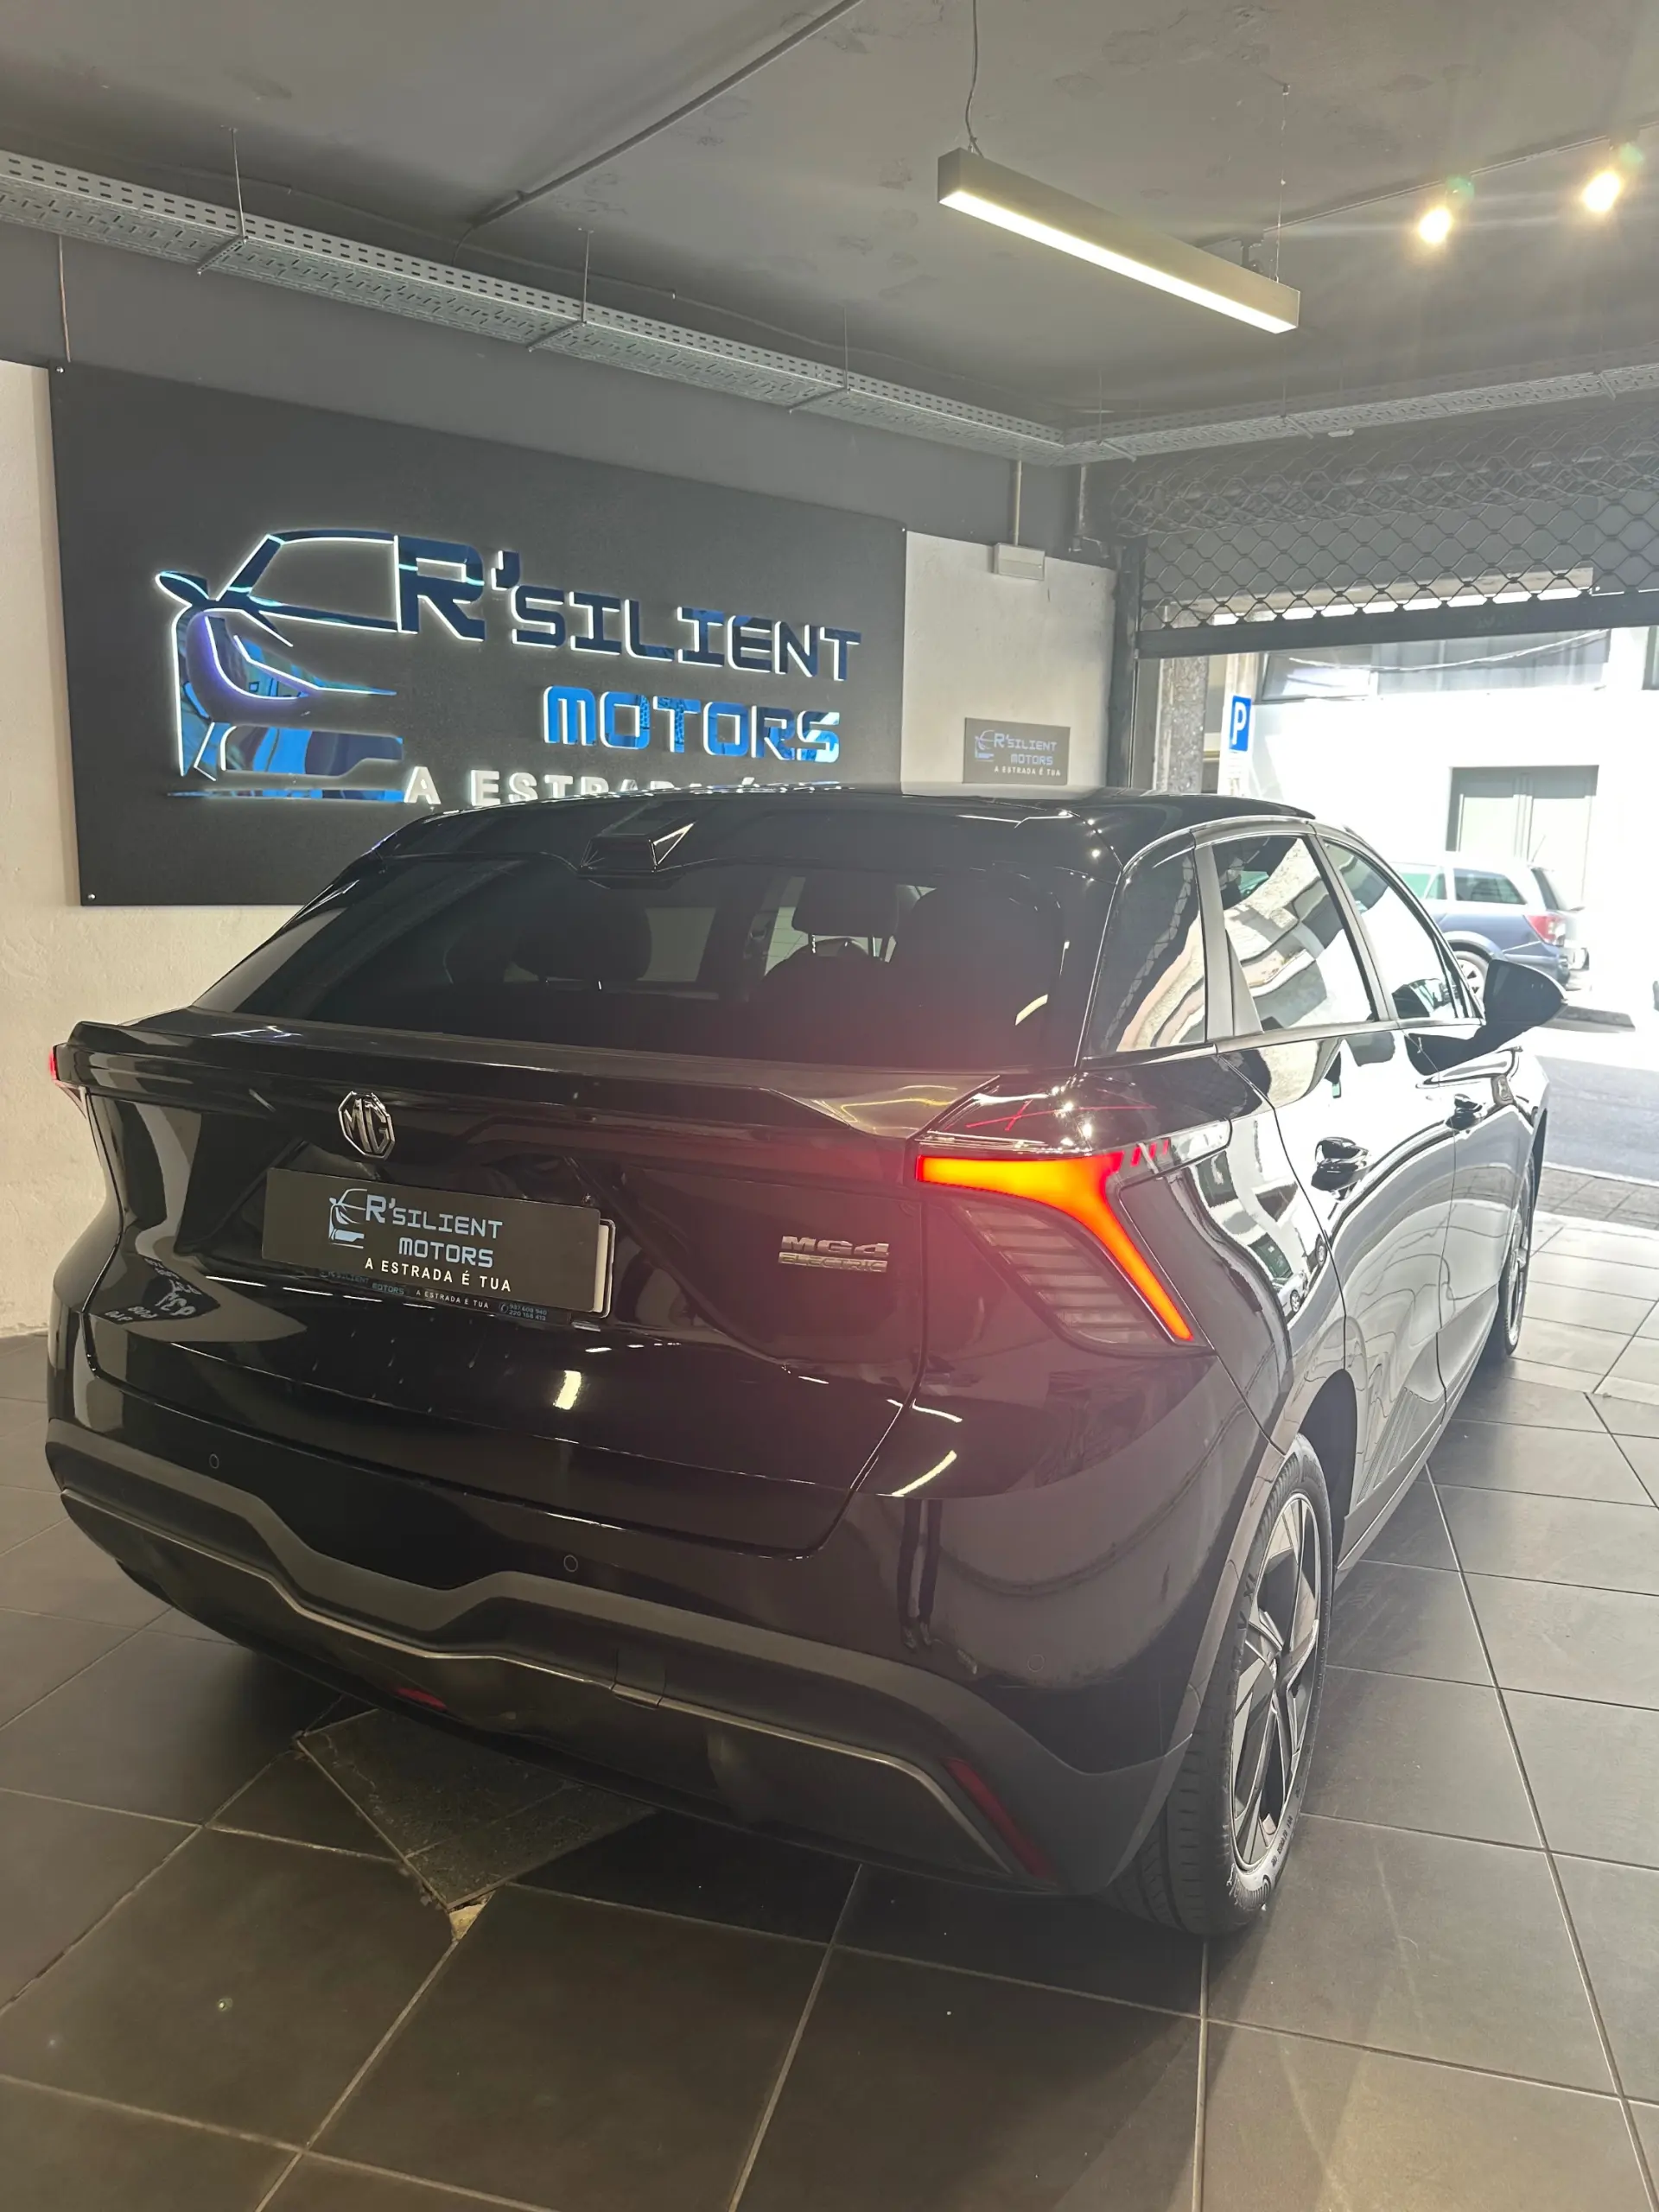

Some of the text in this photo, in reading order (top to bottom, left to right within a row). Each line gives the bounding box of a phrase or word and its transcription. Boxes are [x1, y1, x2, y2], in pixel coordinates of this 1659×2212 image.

[394, 535, 861, 681] R'SILIENT
[543, 685, 840, 763] MOTORS
[1231, 701, 1247, 745] P
[994, 733, 1057, 751] R'SILIENT
[1001, 766, 1036, 775] ESTRADA
[1039, 766, 1044, 776] É
[1010, 753, 1053, 766] MOTORS
[404, 766, 441, 804] A
[343, 1097, 390, 1154] MG
[365, 1194, 503, 1239] R'SILIENT
[398, 1236, 493, 1268] MOTORS
[780, 1253, 887, 1272] ELECTRIC
[781, 1236, 889, 1257] MG4
[365, 1257, 512, 1292] A ESTRADA É TUA
[424, 1291, 461, 1304] ESTRADA
[474, 1300, 489, 1309] TUA
